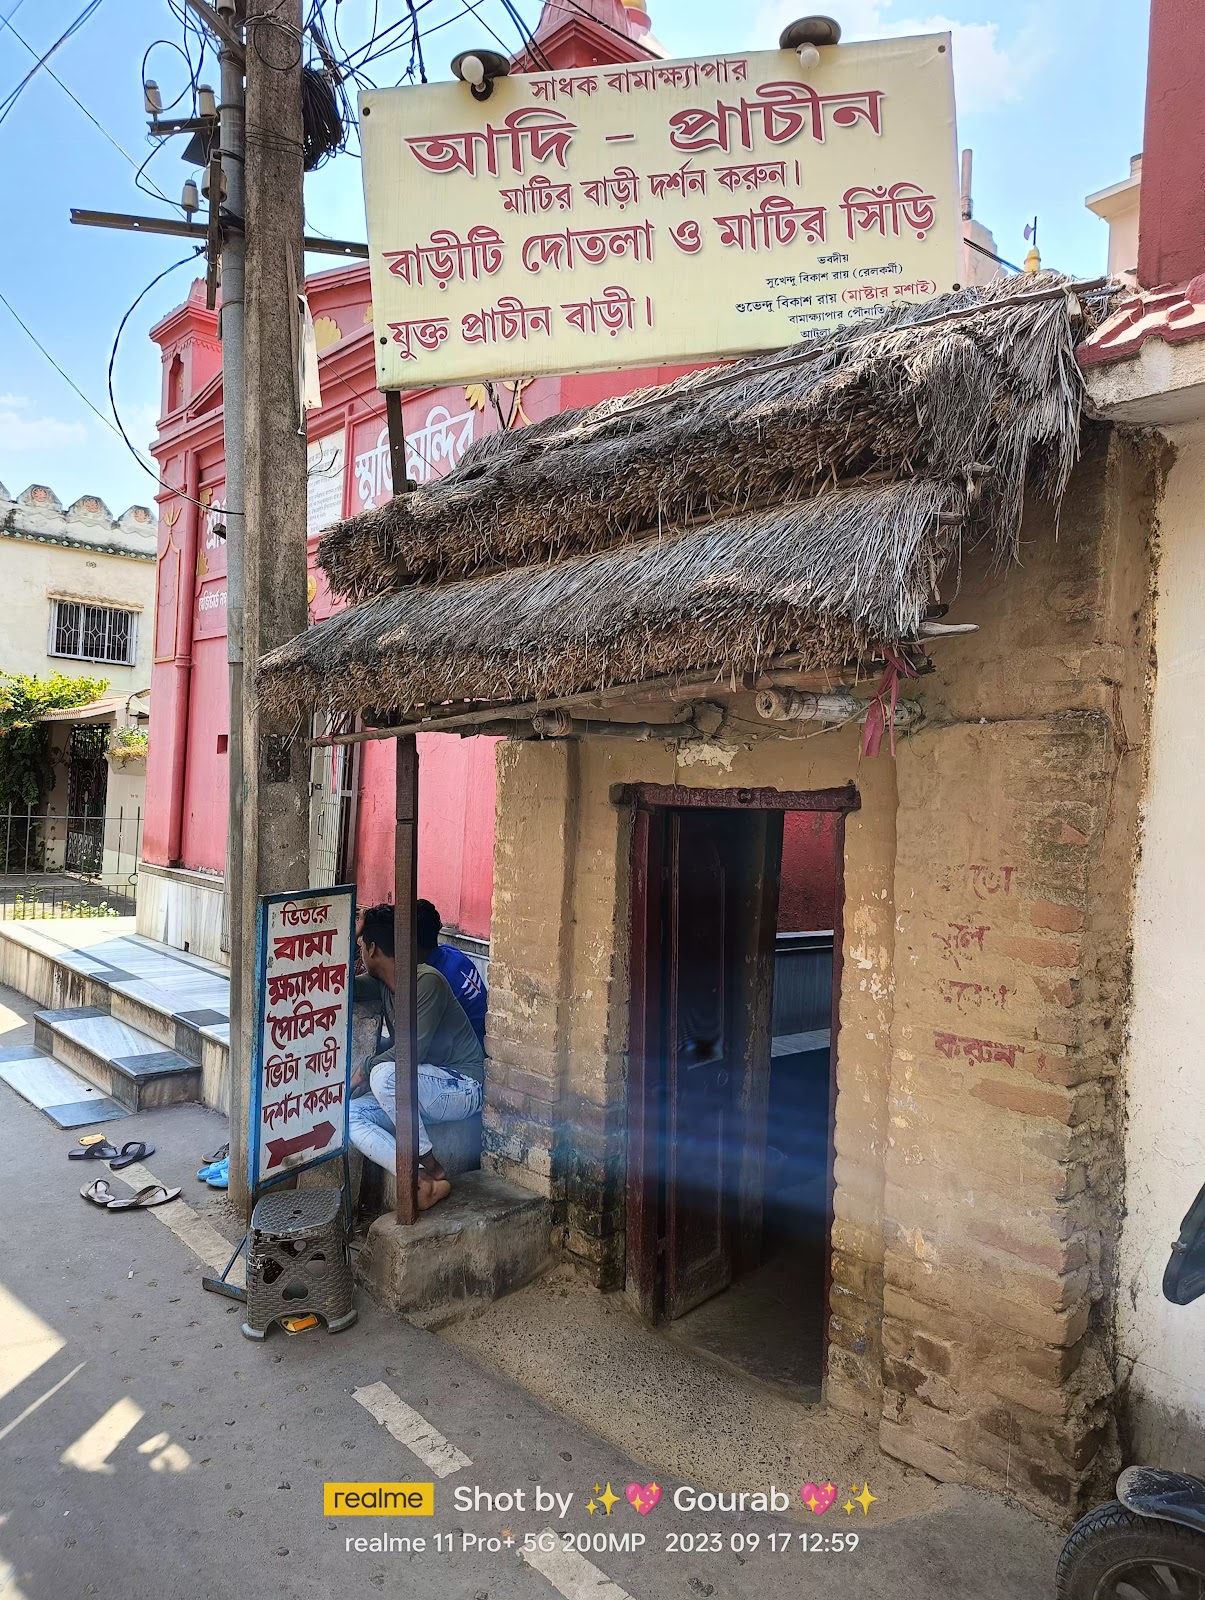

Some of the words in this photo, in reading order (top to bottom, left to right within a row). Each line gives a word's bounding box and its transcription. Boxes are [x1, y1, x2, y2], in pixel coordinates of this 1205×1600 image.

[529, 76, 598, 101] সাধক
[604, 59, 748, 94] বামাক্ষ্যাপার
[404, 107, 578, 177] আদি
[669, 81, 886, 152] প্রাচীন
[499, 175, 572, 214] মাটির
[580, 166, 640, 209] বাড়ী
[647, 158, 706, 200] দর্শন
[382, 225, 505, 290] বাড়ীটি
[522, 219, 655, 273] দোতলা
[669, 220, 701, 254] ও
[713, 195, 827, 250] মাটির
[839, 182, 937, 241] সিঁড়ি
[817, 252, 849, 265] ভবদীয়
[735, 299, 774, 314] শুভেন্দু
[776, 294, 812, 309] বিকাশ
[818, 292, 837, 304] রায়
[893, 280, 937, 296] মশাই)
[765, 275, 796, 289] সুখেন্দু
[798, 271, 829, 285] বিকাশ
[831, 270, 849, 280] রায়
[852, 262, 903, 280] (রেলকর্মী)
[387, 317, 450, 361] যুক্ত
[462, 297, 552, 344] প্রাচীন
[280, 901, 331, 926] ভিতরে
[273, 929, 338, 962] বামা
[267, 963, 347, 1005] ক্ষ্যাপার
[266, 1000, 342, 1050] পৈত্রিক
[265, 1053, 301, 1090] ভিটা
[305, 1037, 340, 1078] বাড়ী
[262, 1093, 302, 1130] দর্শন
[303, 1081, 345, 1116] করুন
